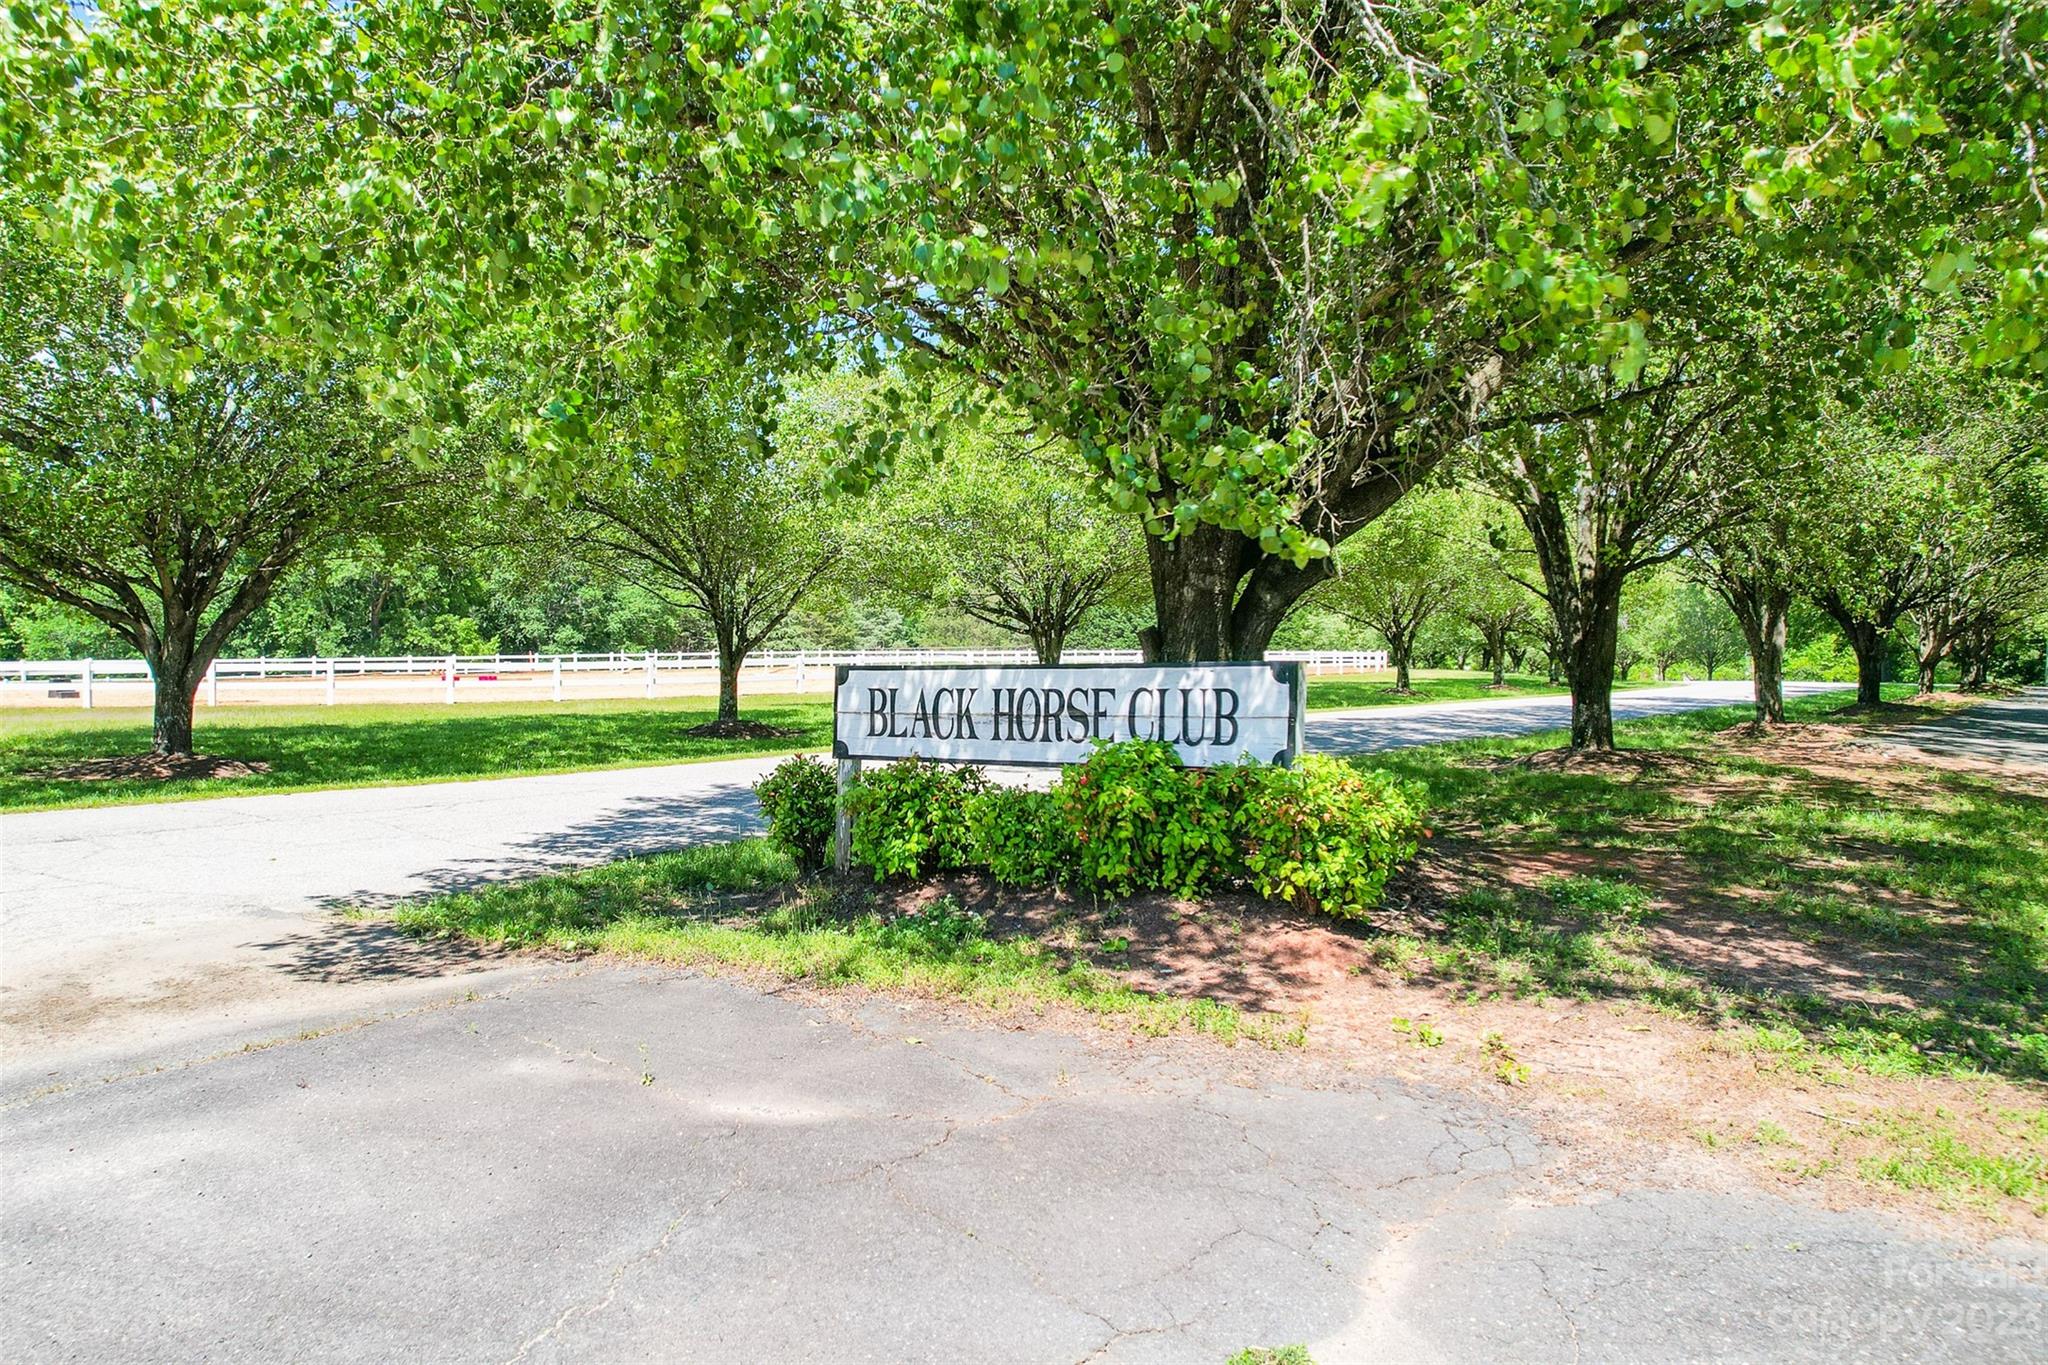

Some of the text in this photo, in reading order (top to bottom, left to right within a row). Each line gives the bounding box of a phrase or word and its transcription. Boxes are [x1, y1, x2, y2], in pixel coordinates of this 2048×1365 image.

[867, 687, 1240, 747] BLACK HORSE CLUB
